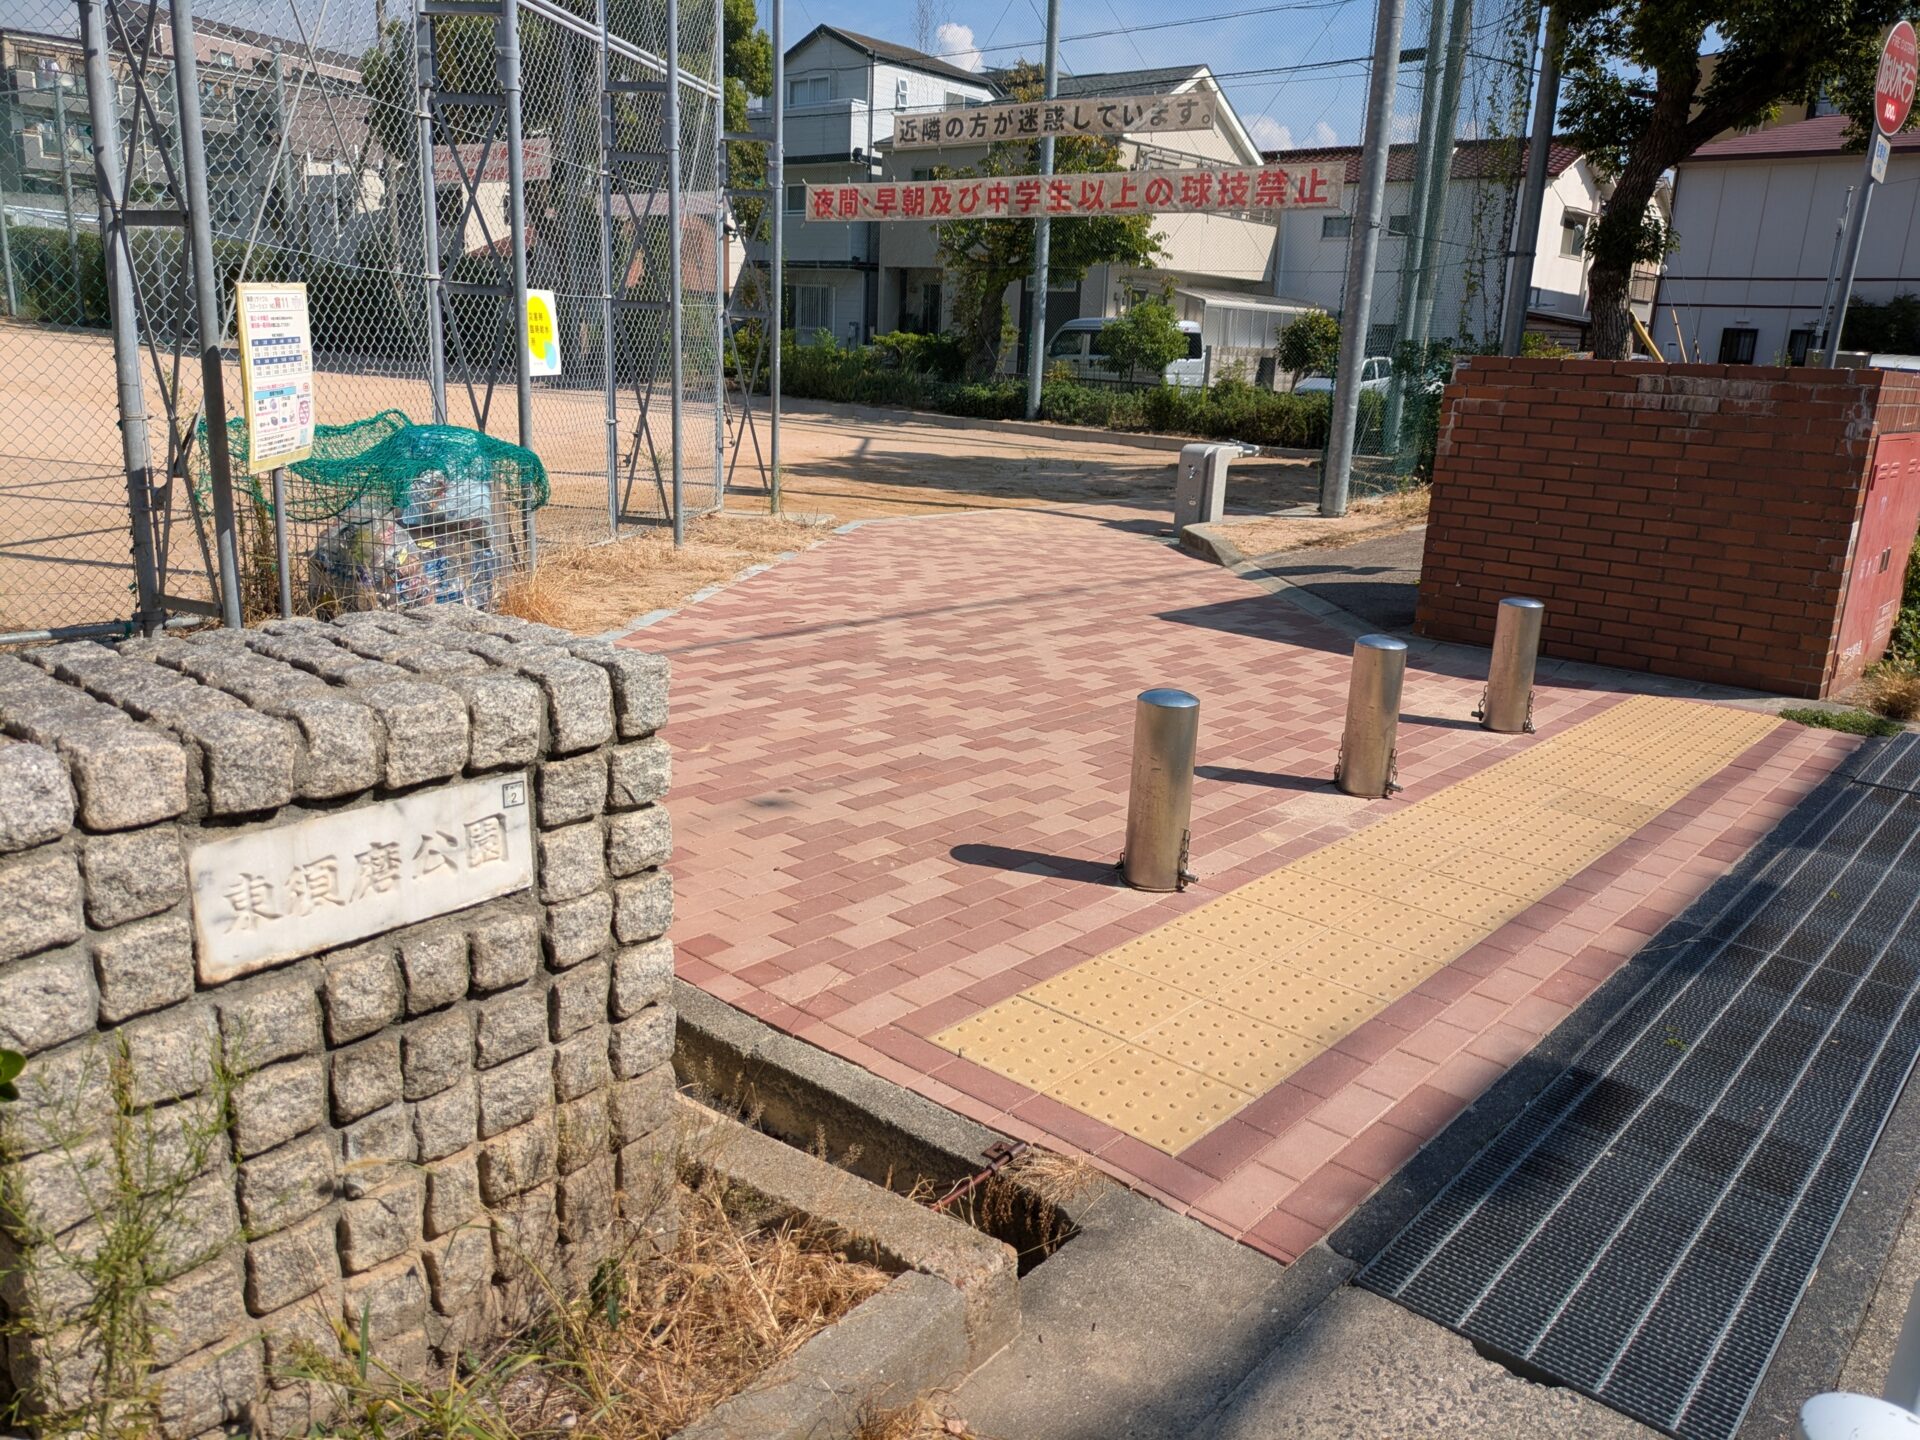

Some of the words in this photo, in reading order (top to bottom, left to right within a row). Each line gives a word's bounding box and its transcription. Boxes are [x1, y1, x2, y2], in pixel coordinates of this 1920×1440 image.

[899, 98, 1211, 143] 近隣の方が迷惑しています。
[511, 792, 518, 804] 2
[223, 812, 509, 935] 東須磨公園
